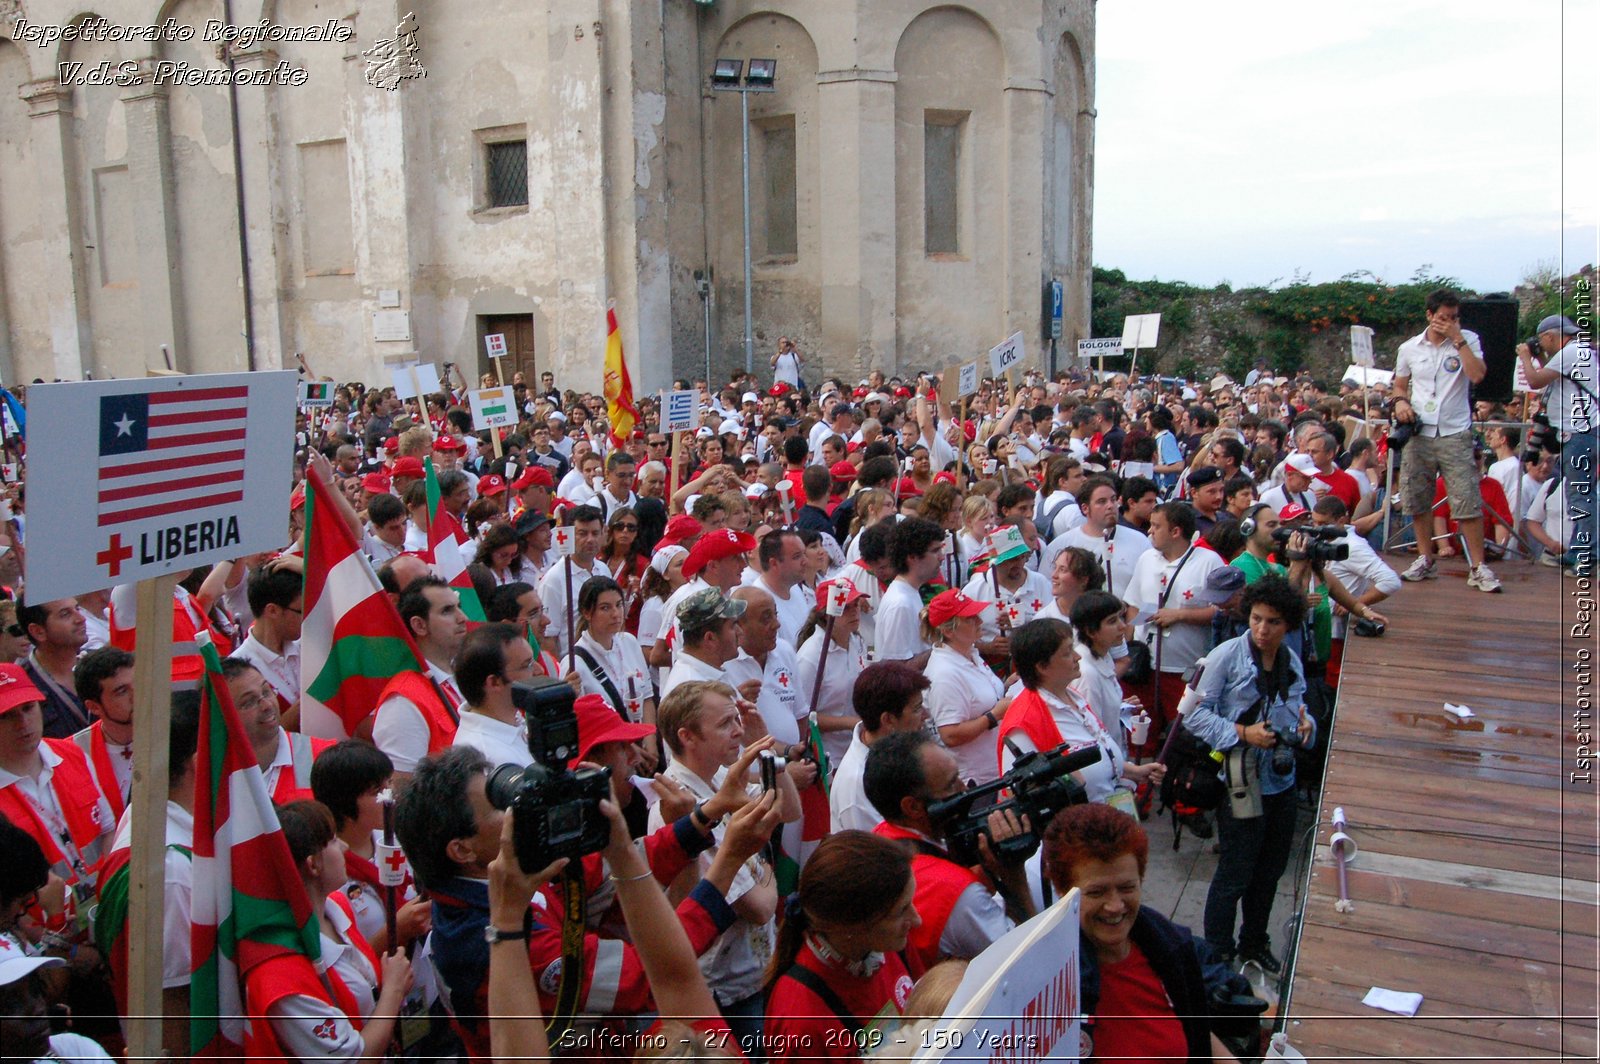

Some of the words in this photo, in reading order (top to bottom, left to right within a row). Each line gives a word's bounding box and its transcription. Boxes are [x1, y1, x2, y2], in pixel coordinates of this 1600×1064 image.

[1053, 287, 1061, 316] P
[1079, 341, 1122, 350] BOLOGNA
[999, 346, 1017, 368] ICRC
[492, 416, 507, 425] INDIA
[674, 420, 690, 430] GREECE
[140, 515, 241, 566] LIBERIA
[1022, 947, 1077, 1064] ITALIANA
